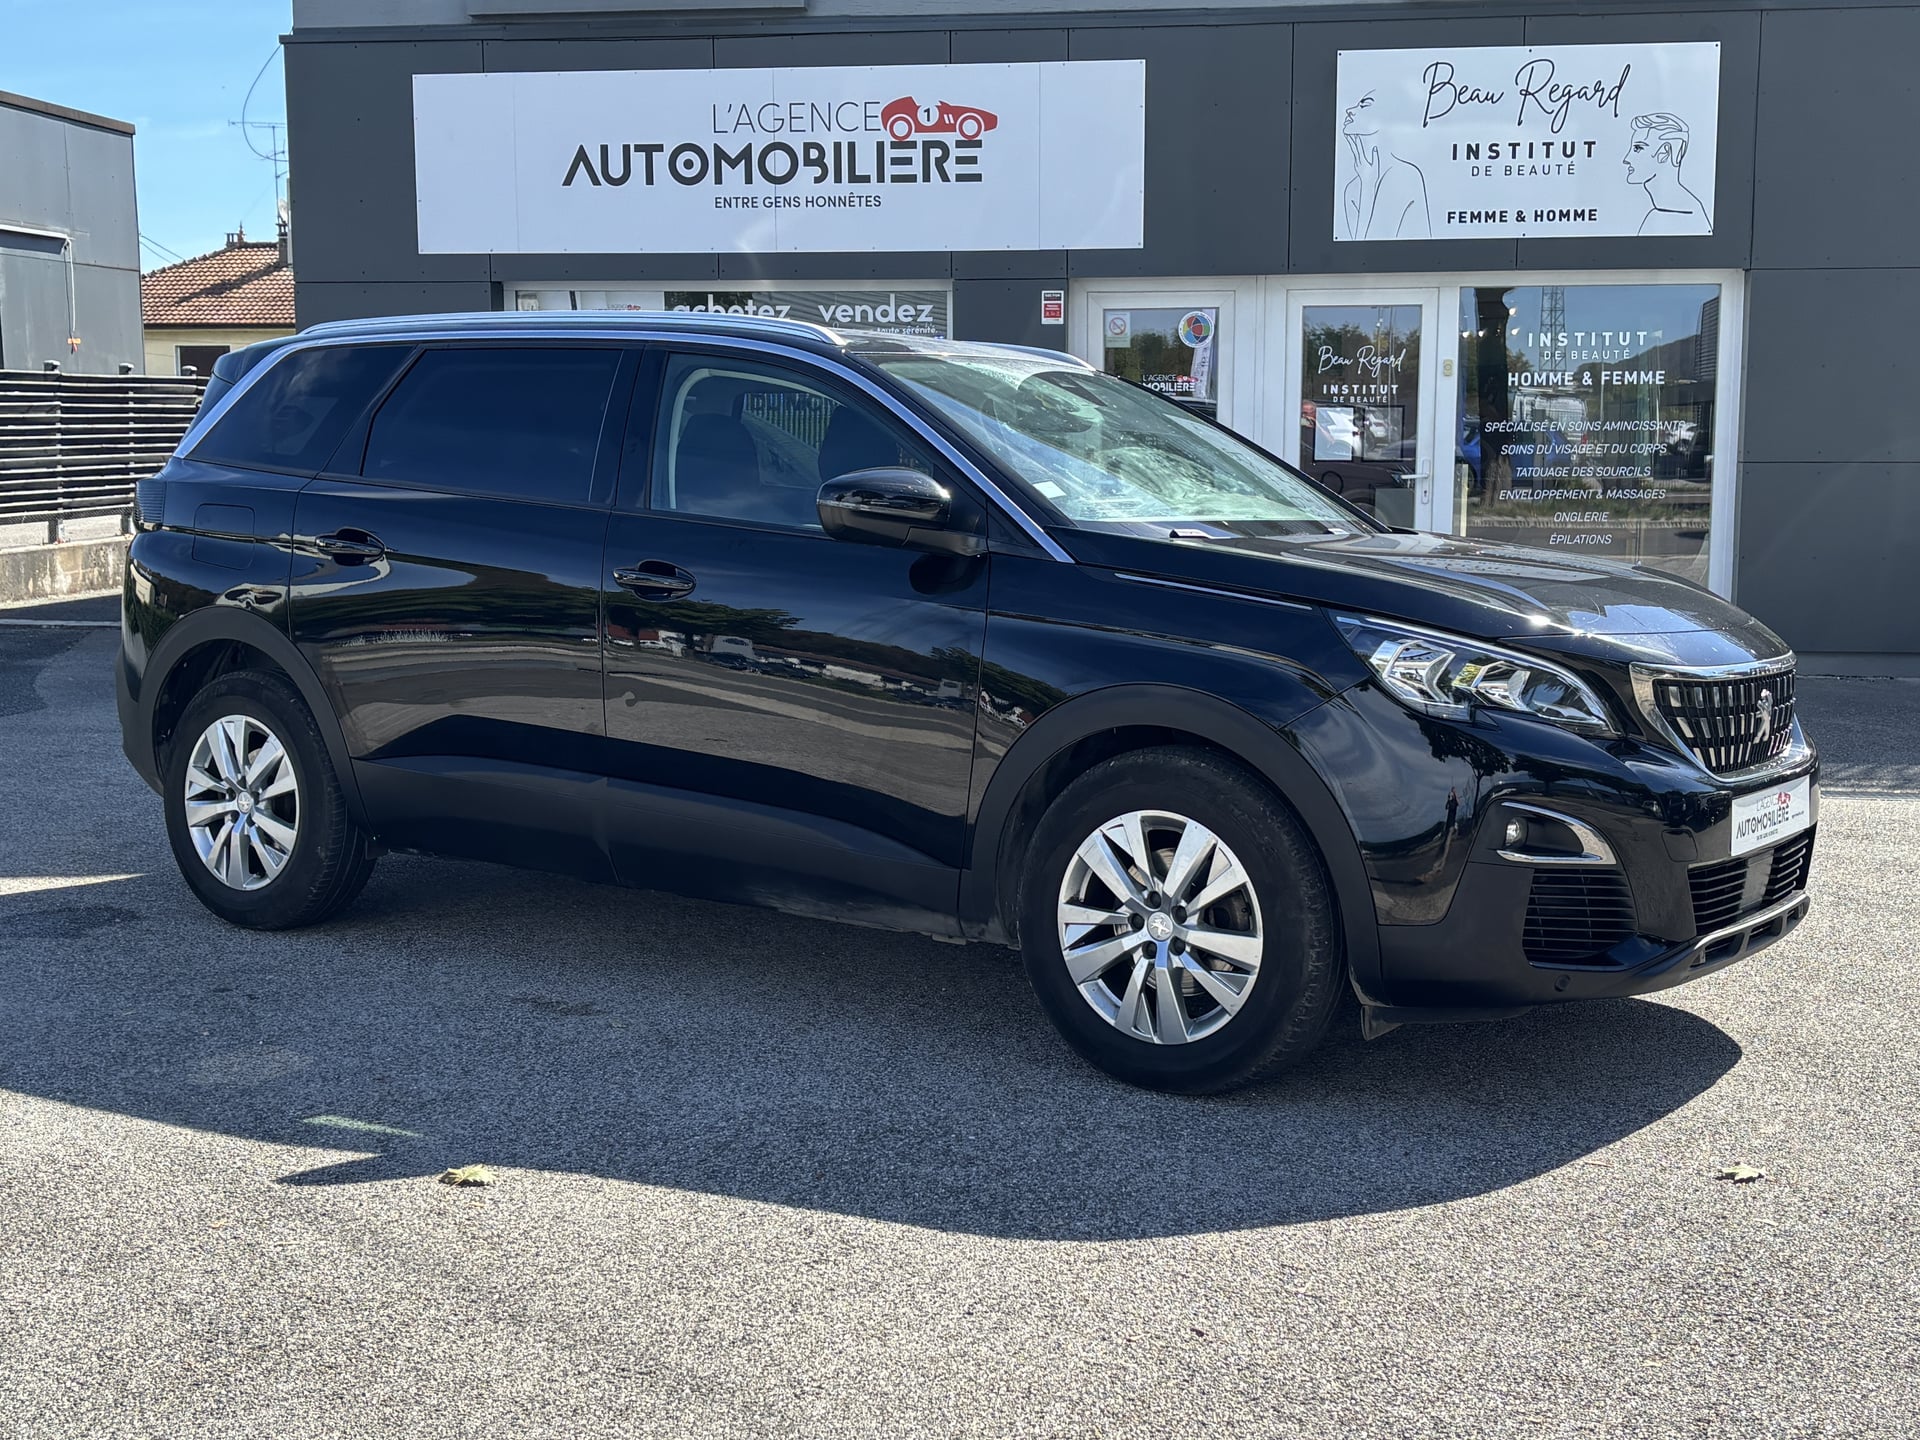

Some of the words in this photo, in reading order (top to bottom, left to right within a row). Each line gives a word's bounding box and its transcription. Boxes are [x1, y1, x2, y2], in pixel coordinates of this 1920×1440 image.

[1422, 61, 1504, 128] Beau
[1515, 58, 1631, 133] Regard
[712, 101, 881, 134] L'AGENCE
[1452, 140, 1597, 160] INSTITUT
[562, 139, 983, 187] AUTOMOBILIERE
[1471, 164, 1492, 177] DE
[1504, 161, 1576, 176] BEAUTÉ
[714, 196, 759, 208] ENTRE
[763, 196, 801, 208] GENS
[806, 192, 882, 208] HONNÊTES
[1447, 210, 1508, 224] FEMME
[1515, 210, 1526, 223] &
[1533, 208, 1598, 222] HOMME
[817, 293, 934, 323] vendez
[1528, 331, 1648, 347] INSTITUT
[1318, 345, 1353, 374] Beau
[1356, 345, 1406, 378] Regard
[1544, 351, 1562, 360] DE
[1571, 349, 1630, 360] BEAUTÉ
[1143, 374, 1177, 382] L'AGENCE
[1508, 372, 1574, 386] HOMME
[1582, 371, 1593, 385] &
[1601, 370, 1666, 385] FEMME
[1323, 384, 1399, 395] INSTITUT
[1350, 395, 1387, 403] BEAUTÉ
[1484, 419, 1548, 432] SPÉCIALISÉ
[1550, 421, 1565, 431] EN
[1567, 421, 1601, 432] SOINS
[1602, 420, 1686, 431] AMINCISSANTS
[1501, 444, 1534, 455] SOINS
[1536, 444, 1552, 454] DU
[1553, 444, 1595, 454] VISAGE
[1596, 444, 1610, 454] ET
[1611, 444, 1627, 454] DU
[1630, 443, 1667, 454] CORPS
[1516, 467, 1570, 477] TATOUAGE
[1572, 467, 1593, 477] DES
[1596, 466, 1652, 477] SOURCILS
[1499, 489, 1596, 500] ENVELOPPEMENT
[1596, 489, 1603, 499] &
[1606, 489, 1667, 499] MASSAGES
[1553, 511, 1610, 522] ONGLERIE
[1549, 532, 1613, 545] ÉPILATIONS
